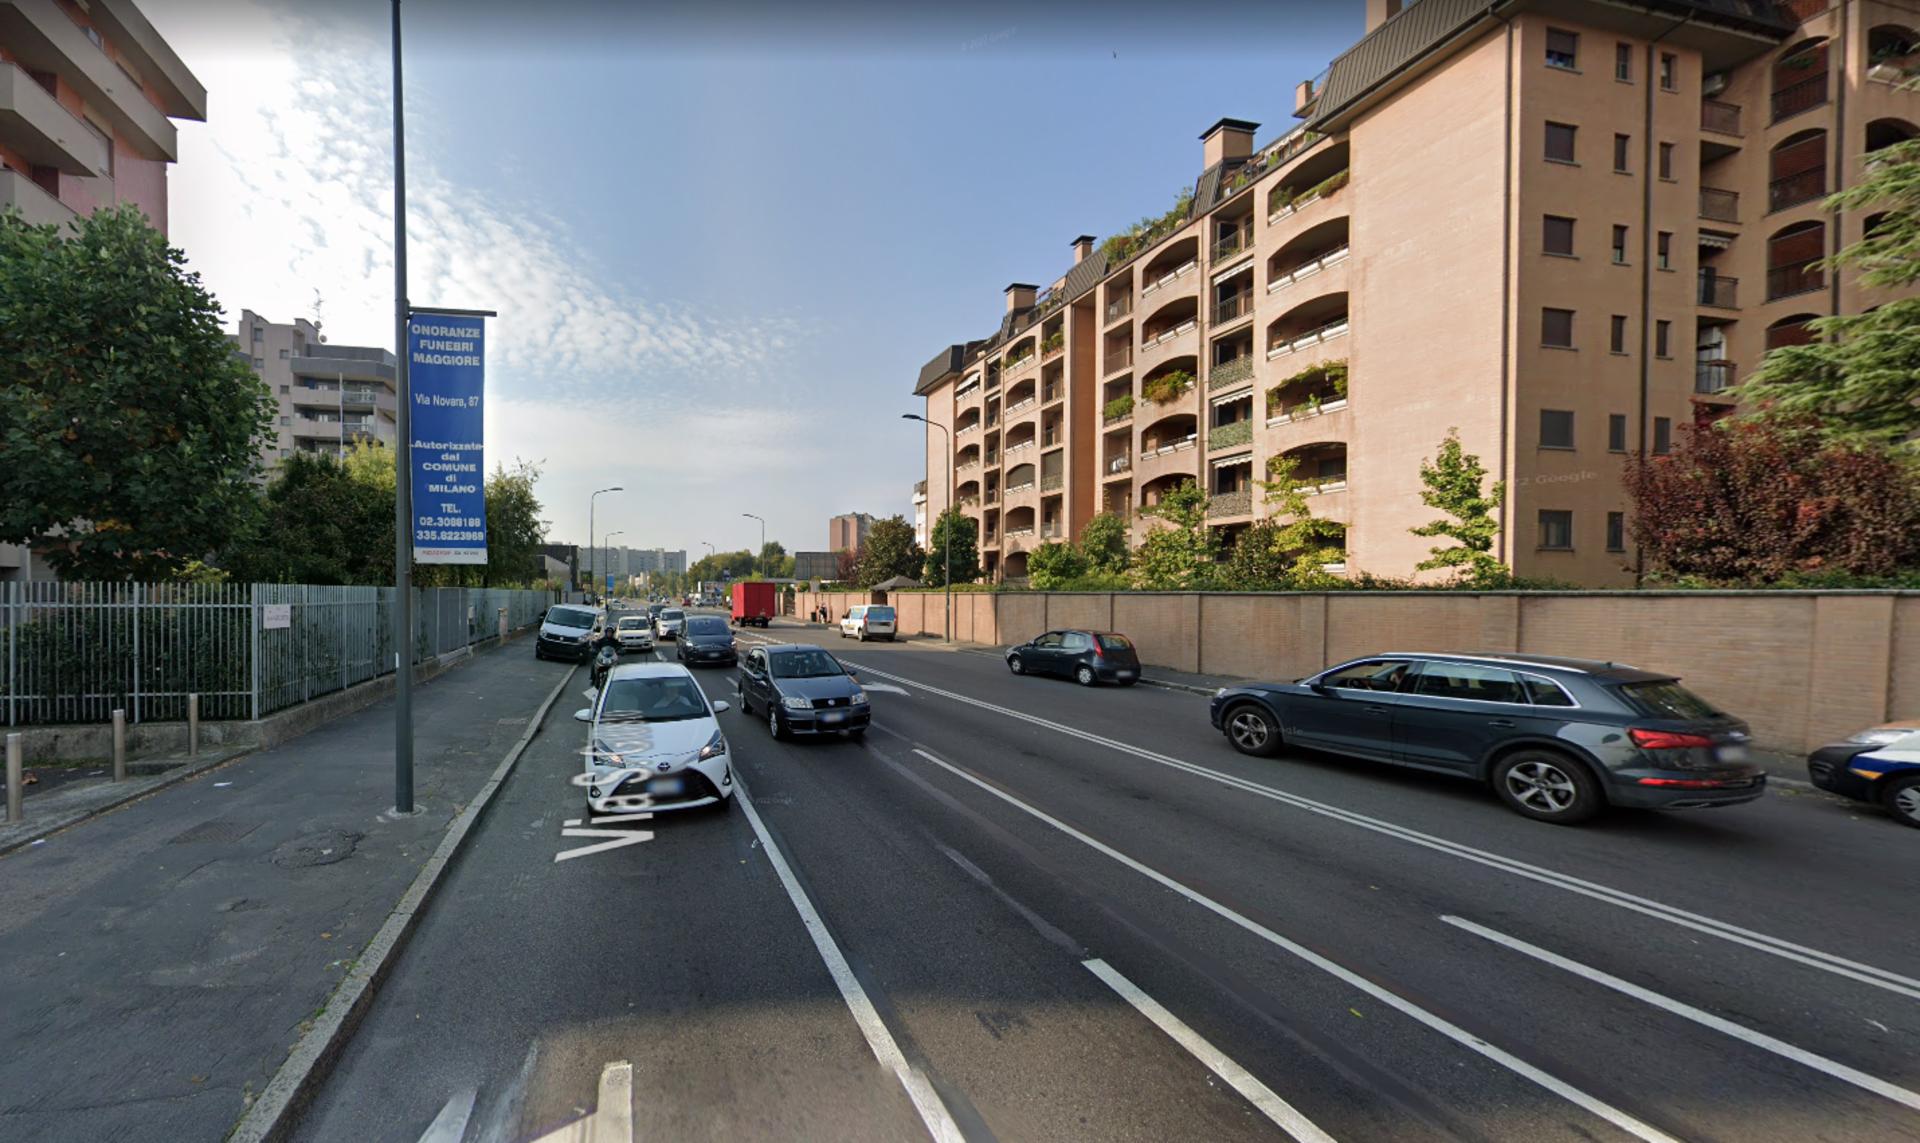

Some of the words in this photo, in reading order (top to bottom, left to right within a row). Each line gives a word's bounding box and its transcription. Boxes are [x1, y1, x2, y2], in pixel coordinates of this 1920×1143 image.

[412, 324, 481, 338] ONORANZE
[420, 340, 474, 351] FUNEBRI
[415, 393, 430, 405] Via
[433, 395, 467, 408] Novara,
[441, 453, 460, 461] dal
[422, 462, 477, 472] COMUNE
[445, 474, 457, 483] di
[428, 484, 476, 493] MILANO
[441, 503, 461, 513] TEL.
